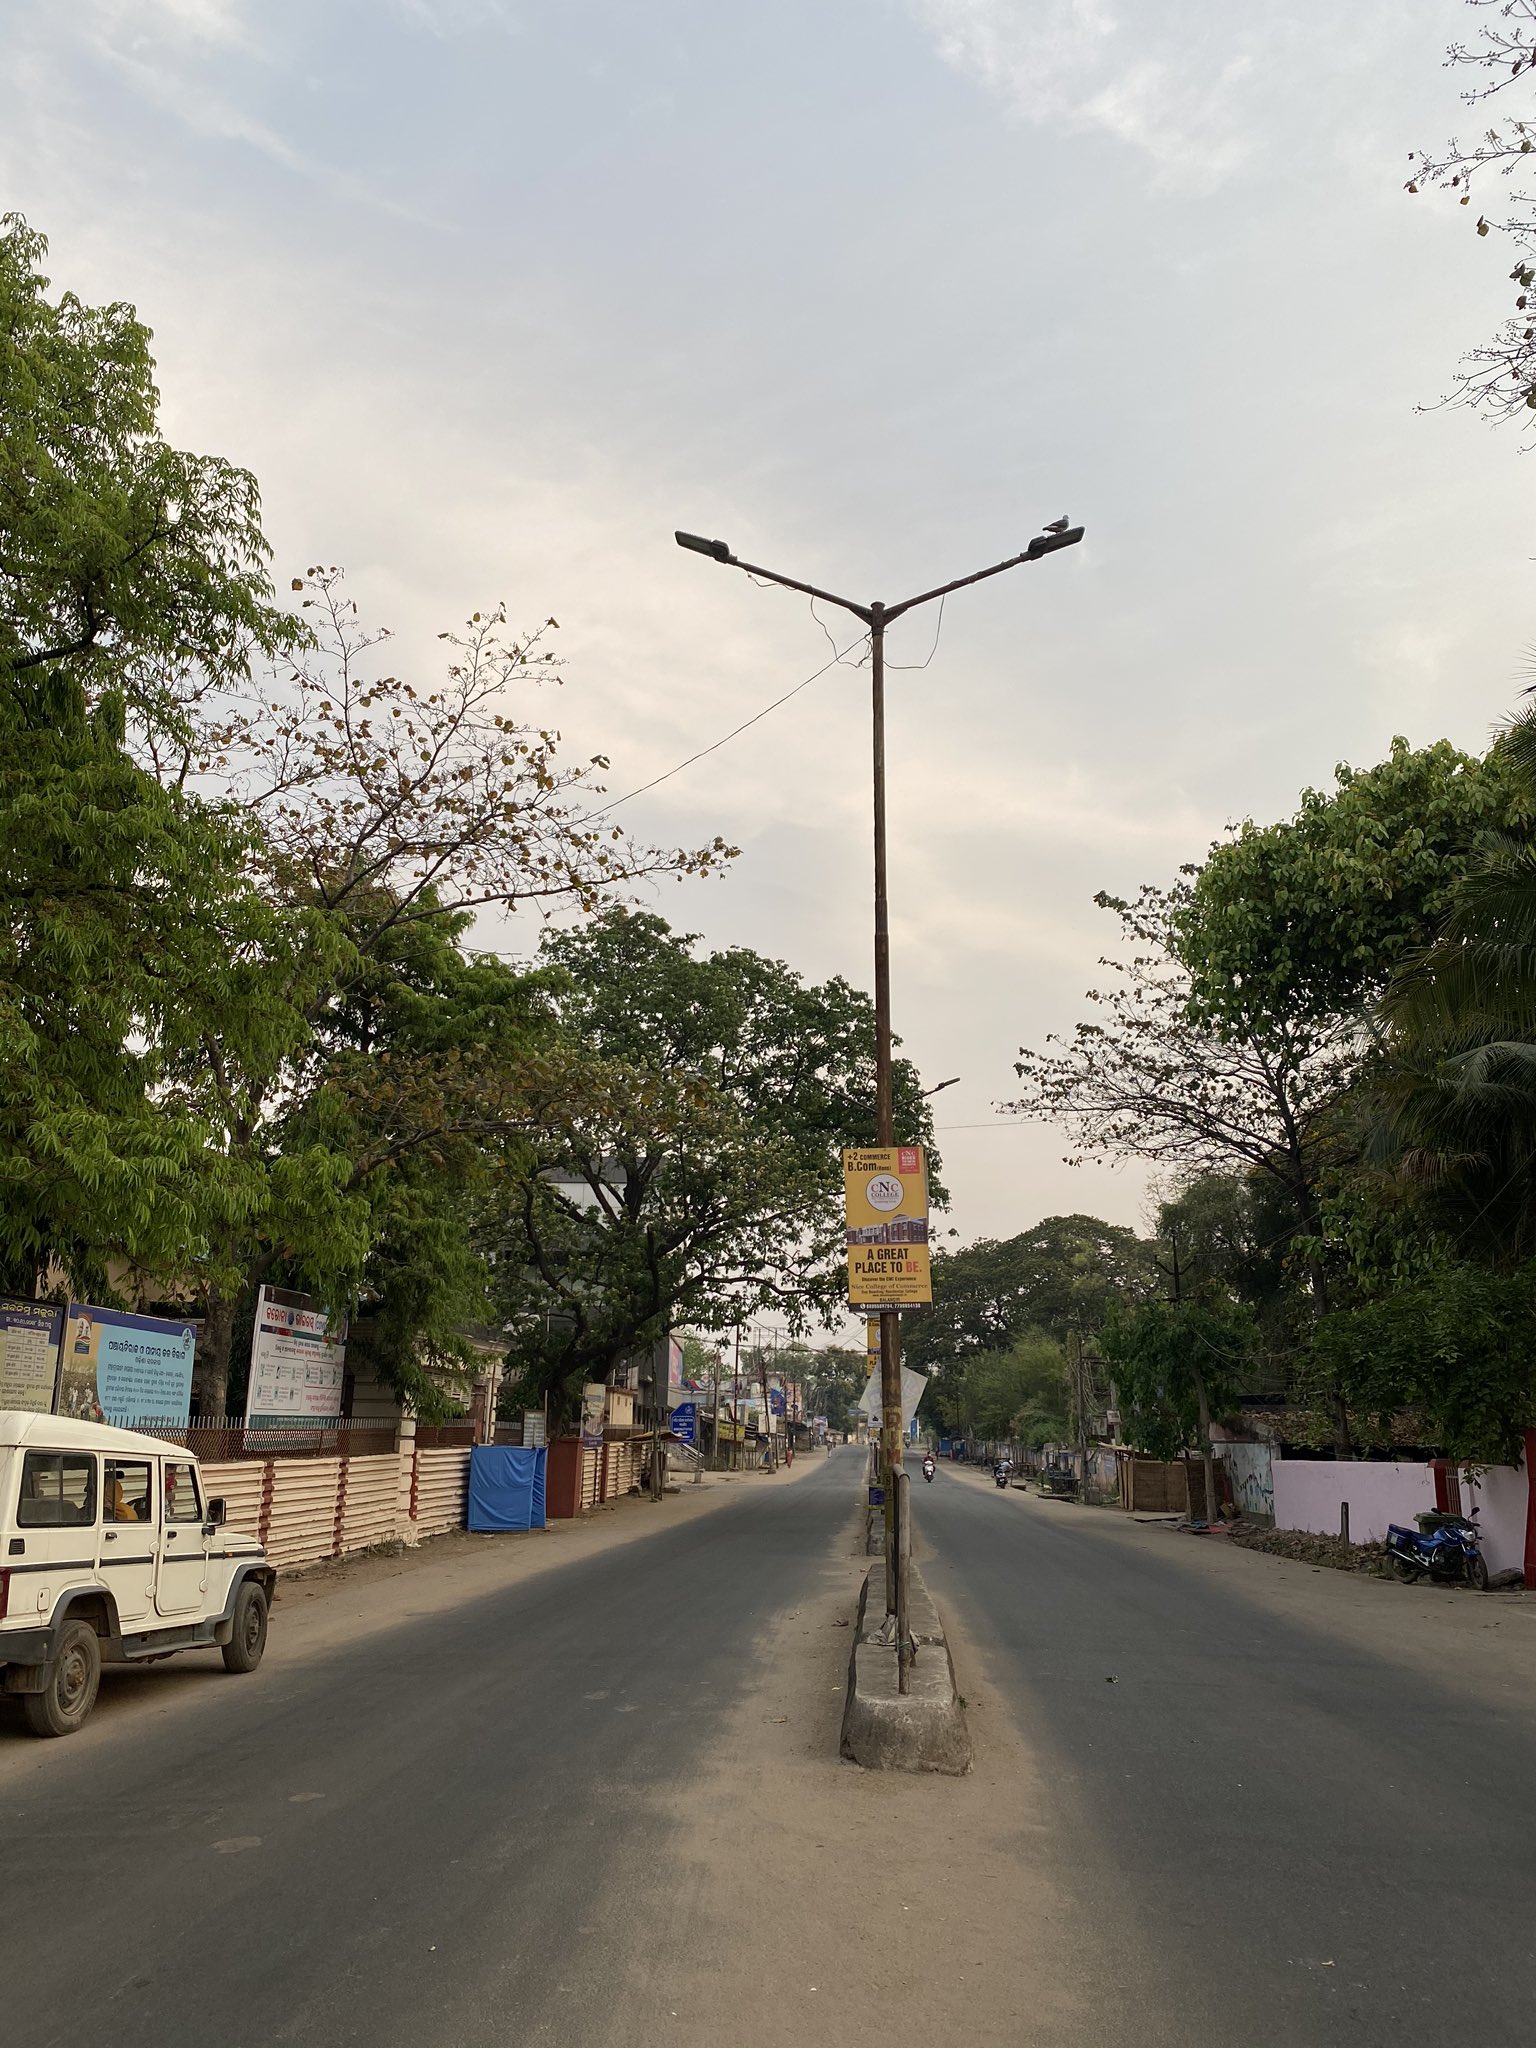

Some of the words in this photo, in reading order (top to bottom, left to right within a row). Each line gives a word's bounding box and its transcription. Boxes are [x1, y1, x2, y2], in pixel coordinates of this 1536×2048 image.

[848, 1152, 858, 1161] +2
[871, 1181, 899, 1193] CNC
[867, 1249, 874, 1260] A
[877, 1248, 909, 1260] GREAT
[855, 1262, 887, 1273] PLACE
[890, 1262, 903, 1273] TO
[906, 1261, 922, 1273] BE.
